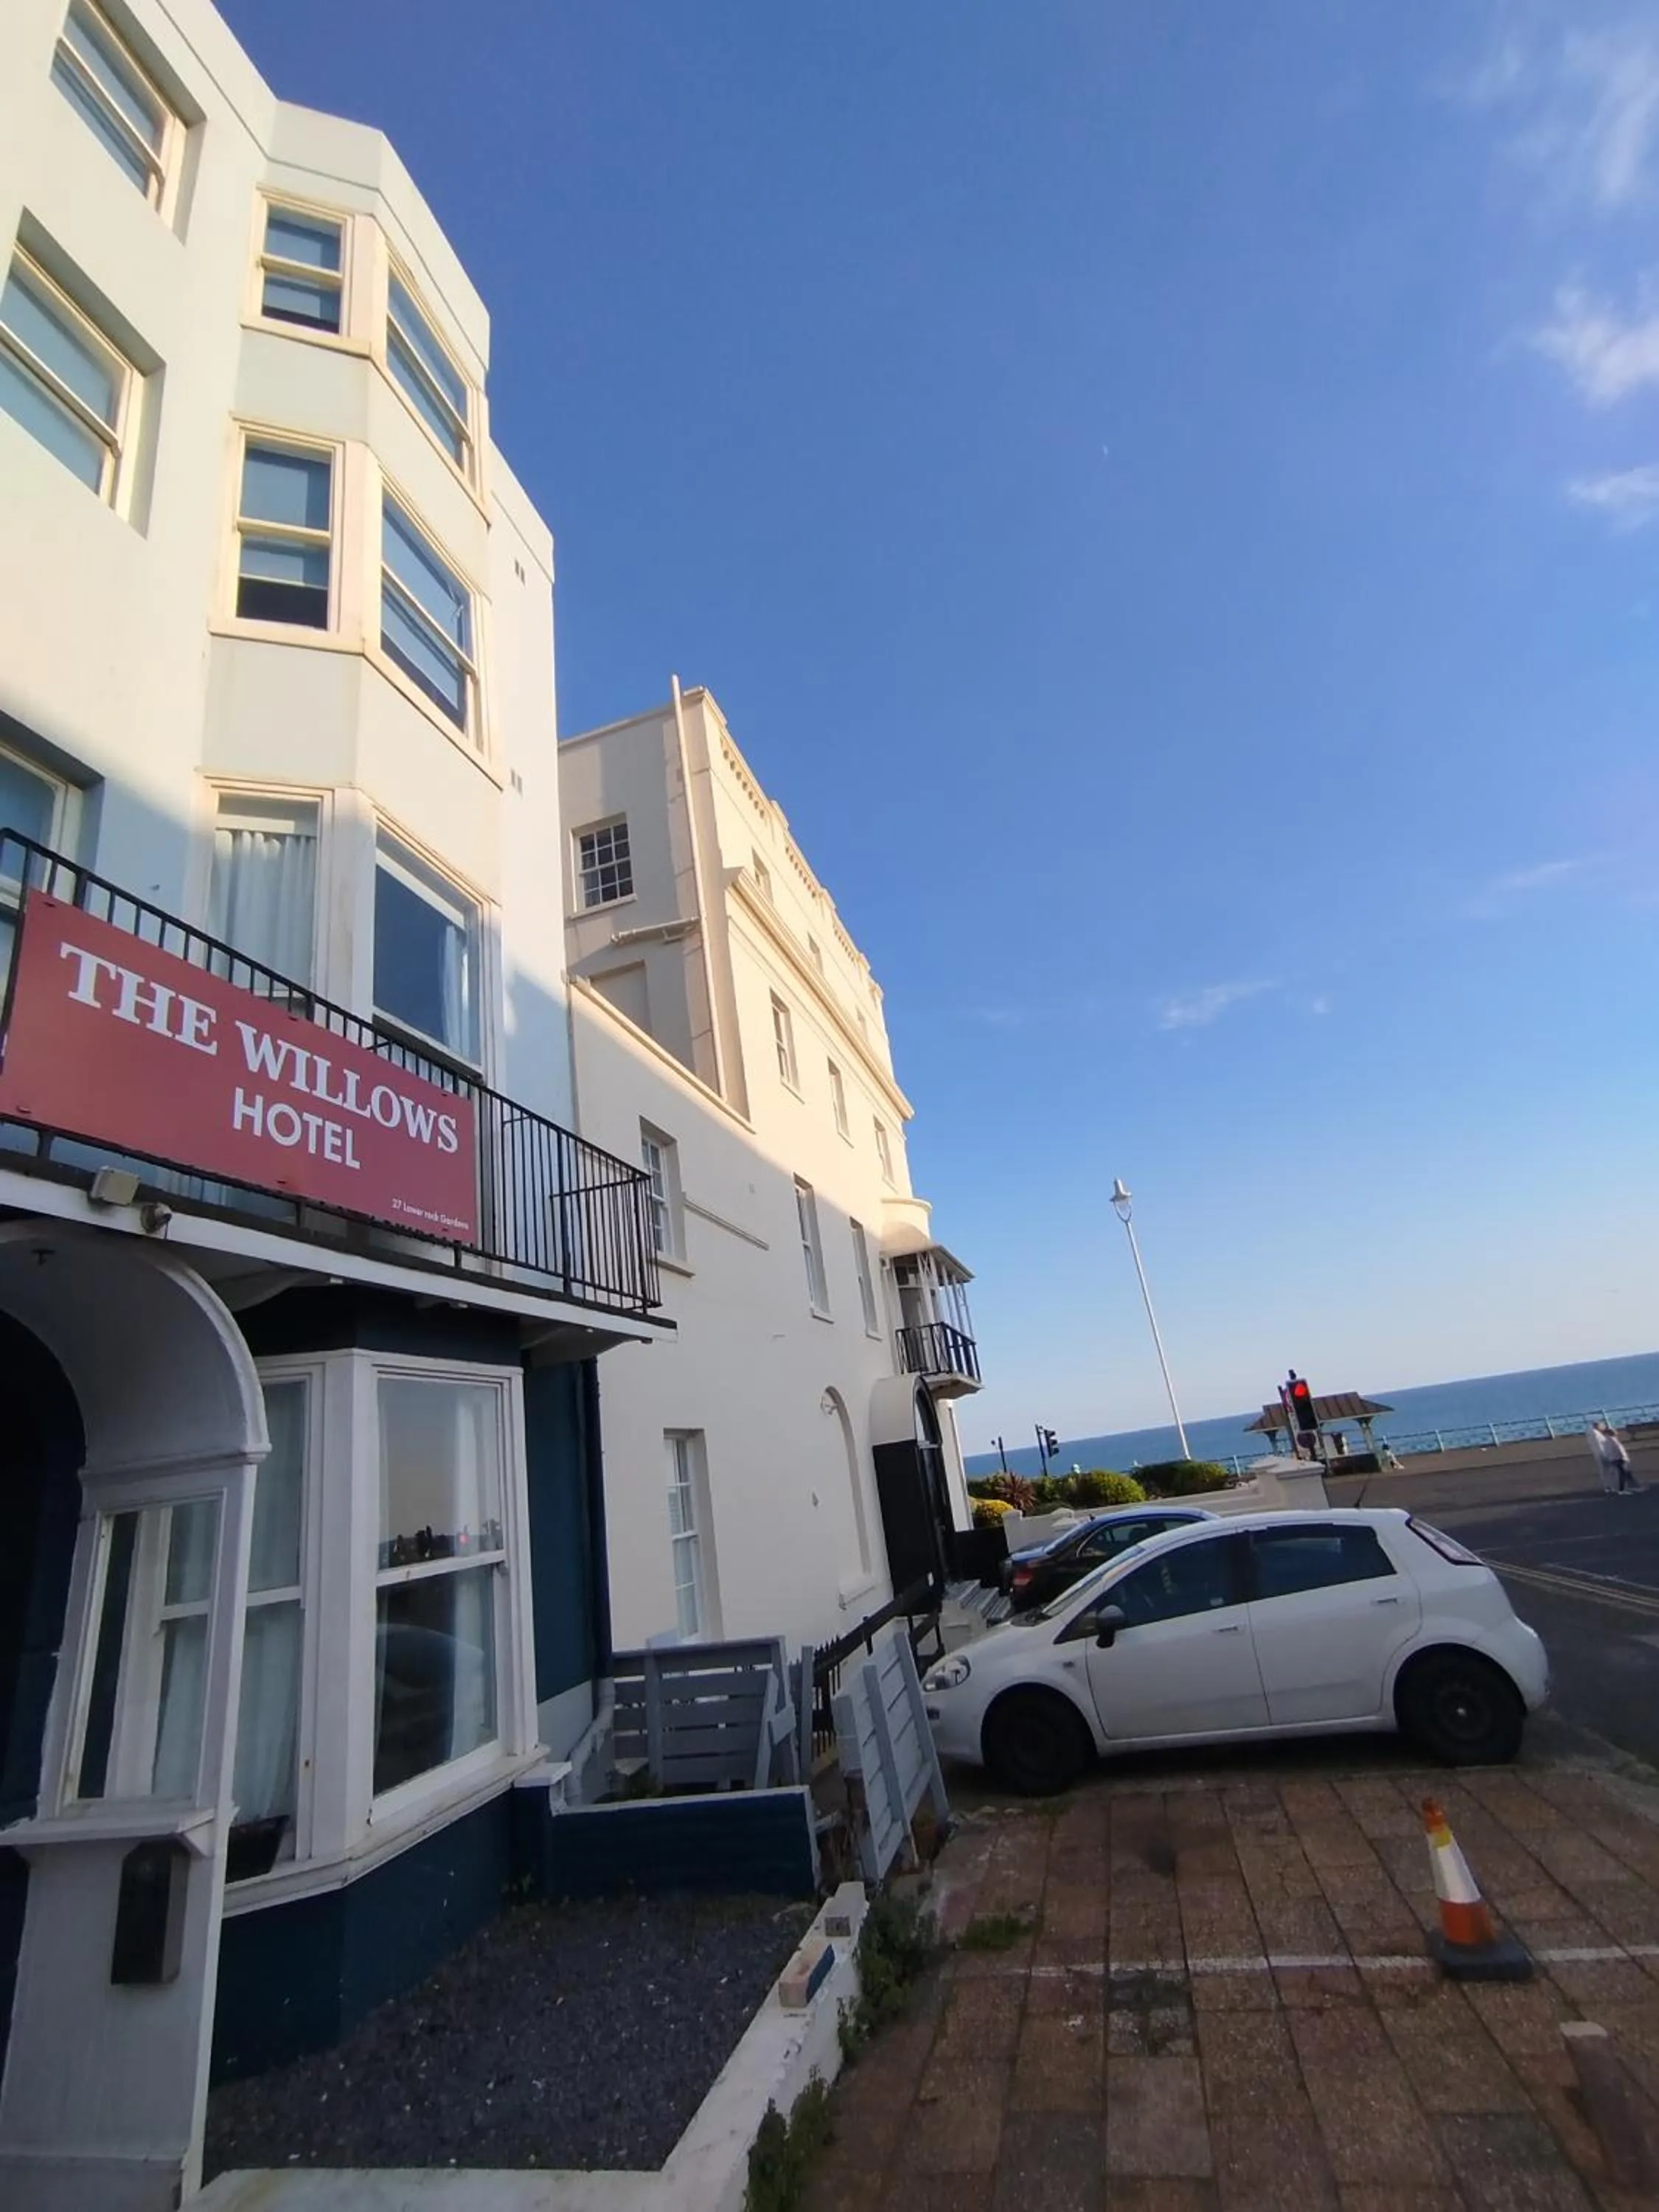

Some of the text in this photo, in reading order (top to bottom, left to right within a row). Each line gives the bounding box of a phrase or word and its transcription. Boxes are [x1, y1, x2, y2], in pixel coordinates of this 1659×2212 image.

[60, 942, 458, 1153] THE WILLOWS
[233, 1088, 361, 1169] HOTEL
[392, 1197, 402, 1209] 27
[440, 1214, 469, 1230] Gardens
